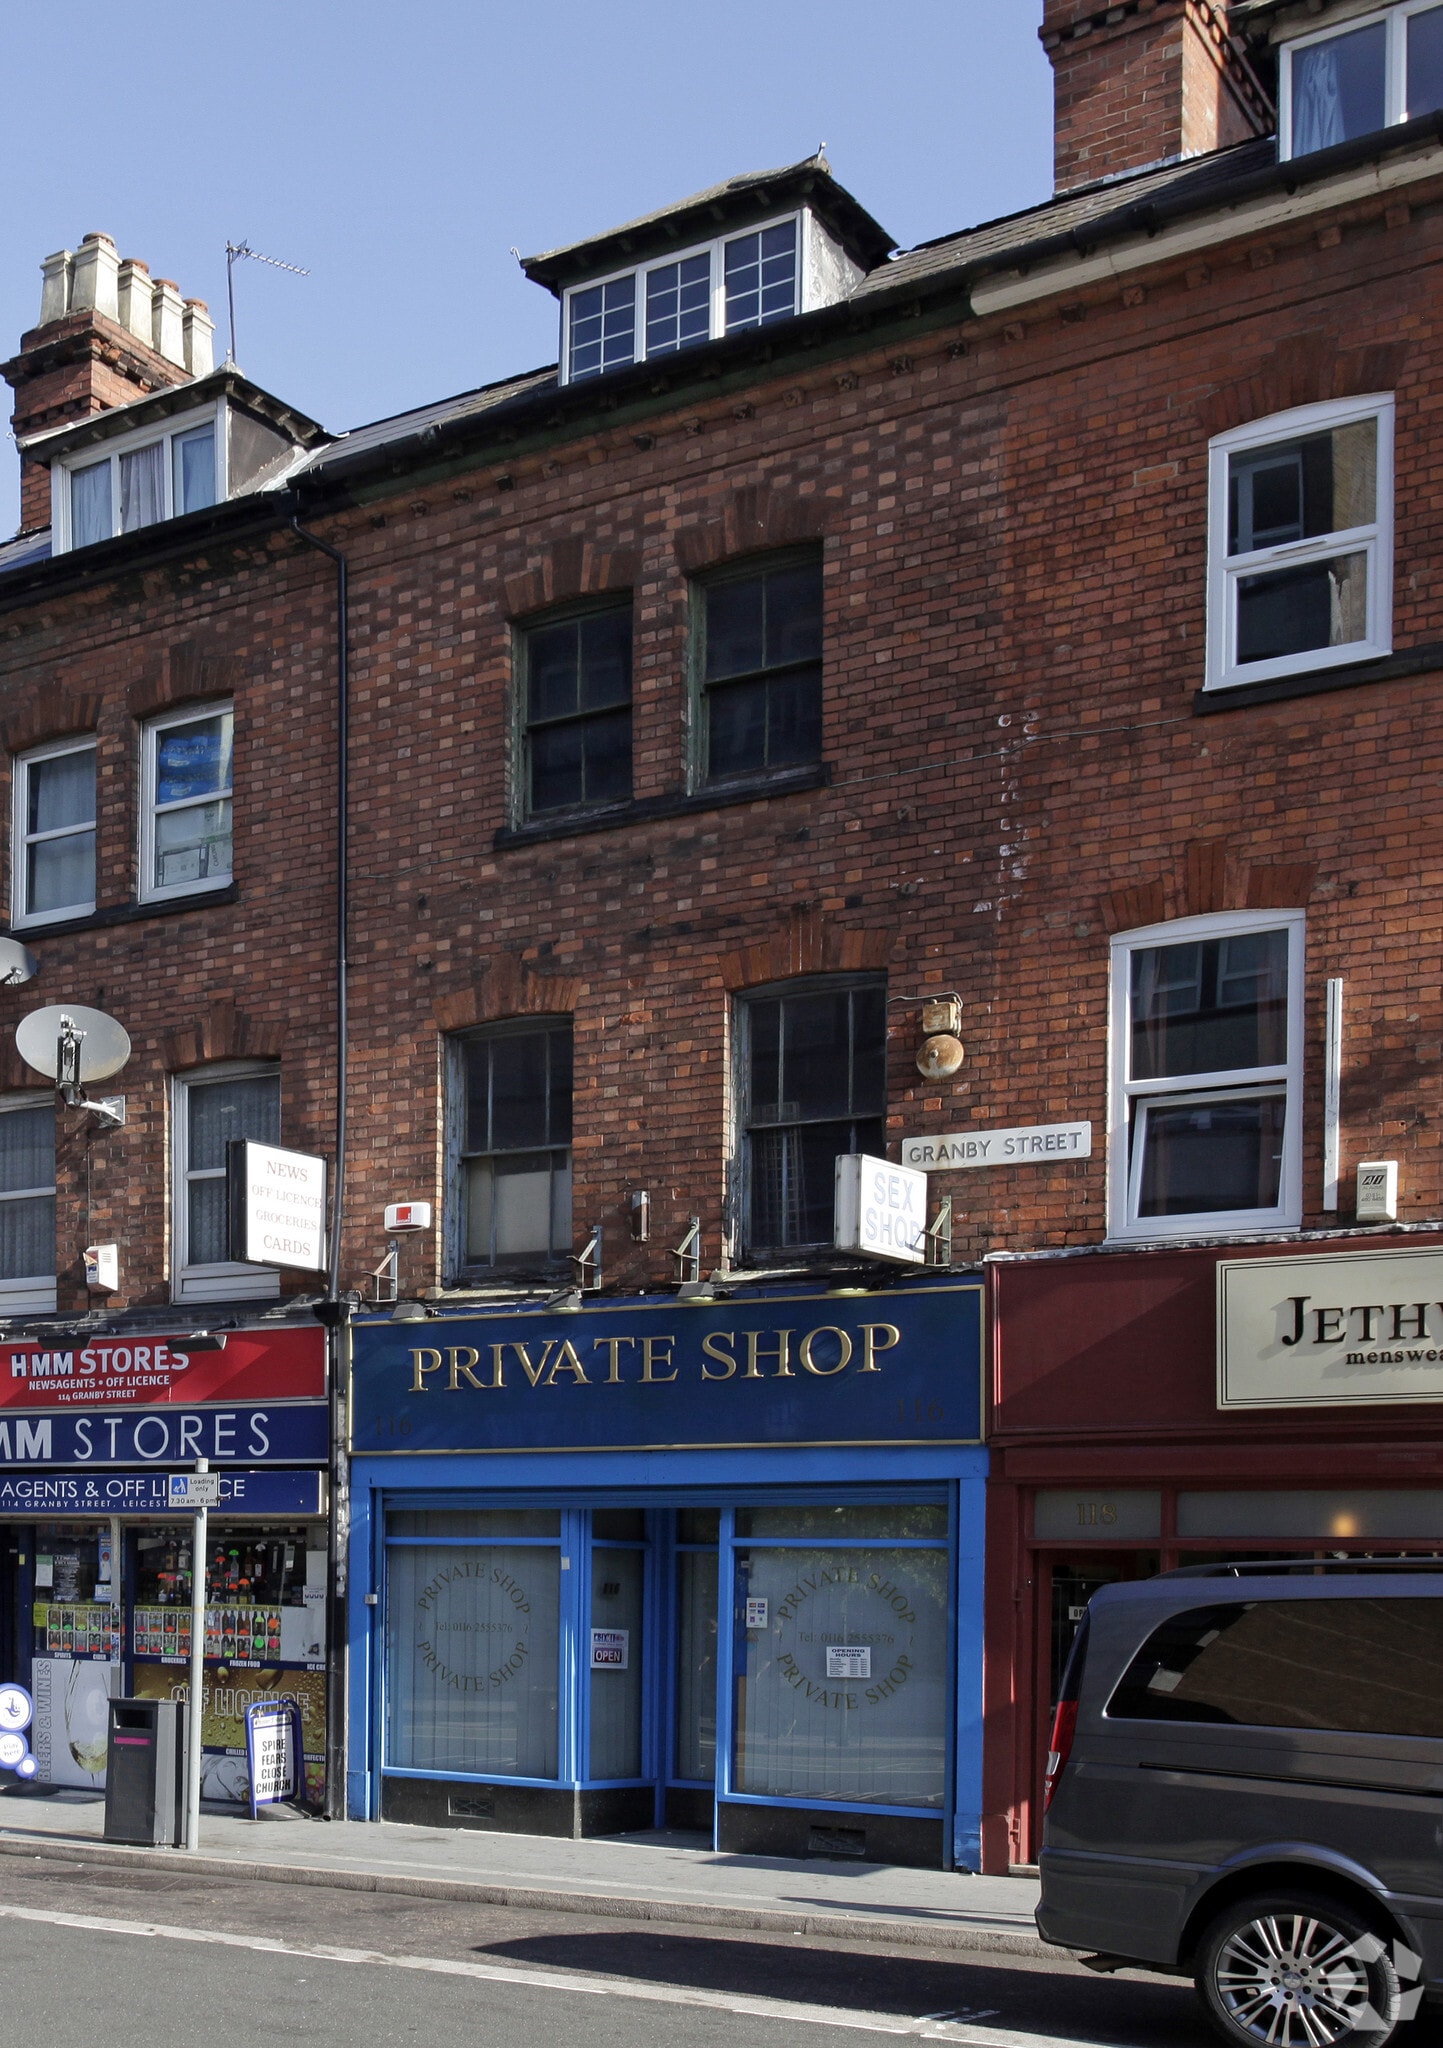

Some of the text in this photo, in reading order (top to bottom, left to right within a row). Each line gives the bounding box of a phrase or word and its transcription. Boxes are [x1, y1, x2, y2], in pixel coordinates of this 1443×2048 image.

[909, 1131, 1083, 1163] GRANBY STREET
[266, 1160, 308, 1182] NEWS
[251, 1184, 323, 1209] OFF LICENCE
[873, 1171, 914, 1213] SEX
[255, 1208, 318, 1231] GROCERIES
[865, 1208, 922, 1249] SHOP
[263, 1234, 311, 1256] CARDS
[1281, 1295, 1443, 1347] JETH
[79, 1345, 190, 1375] STORES
[408, 1323, 900, 1392] PRIVATE SHOP
[29, 1374, 170, 1391] NEWSAGENTS OFF LICENCE
[58, 1389, 137, 1402] 114 GRANBY STREET
[73, 1412, 270, 1460] STORES
[0, 1479, 245, 1498] AGENTS & OFF LICE
[190, 1478, 215, 1488] Loading
[24, 1500, 70, 1508] GRANBY
[74, 1500, 117, 1508] STREET,
[1077, 1503, 1117, 1526] 118
[417, 1561, 532, 1614] PRIVATE SHOP
[777, 1566, 861, 1621] PRIVATE
[866, 1572, 917, 1625] SHOP
[435, 1621, 451, 1632] Tel:
[799, 1632, 817, 1643] Tel:
[821, 1633, 844, 1643] 0116
[160, 1656, 187, 1665] GROCERIES
[229, 1659, 261, 1669] FROZEN FOOD
[306, 1663, 315, 1671] ICE
[417, 1641, 528, 1693] PRIVATE SHOP
[595, 1650, 621, 1663] OPEN
[776, 1652, 914, 1710] PRIVATE SHOP
[215, 1688, 311, 1722] LICENCE
[37, 1660, 52, 1782] BEERS & WINES
[262, 1738, 286, 1753] SPIRE
[261, 1752, 287, 1766] FEARS
[261, 1765, 287, 1780] CLOSE
[256, 1778, 291, 1794] CHURCH
